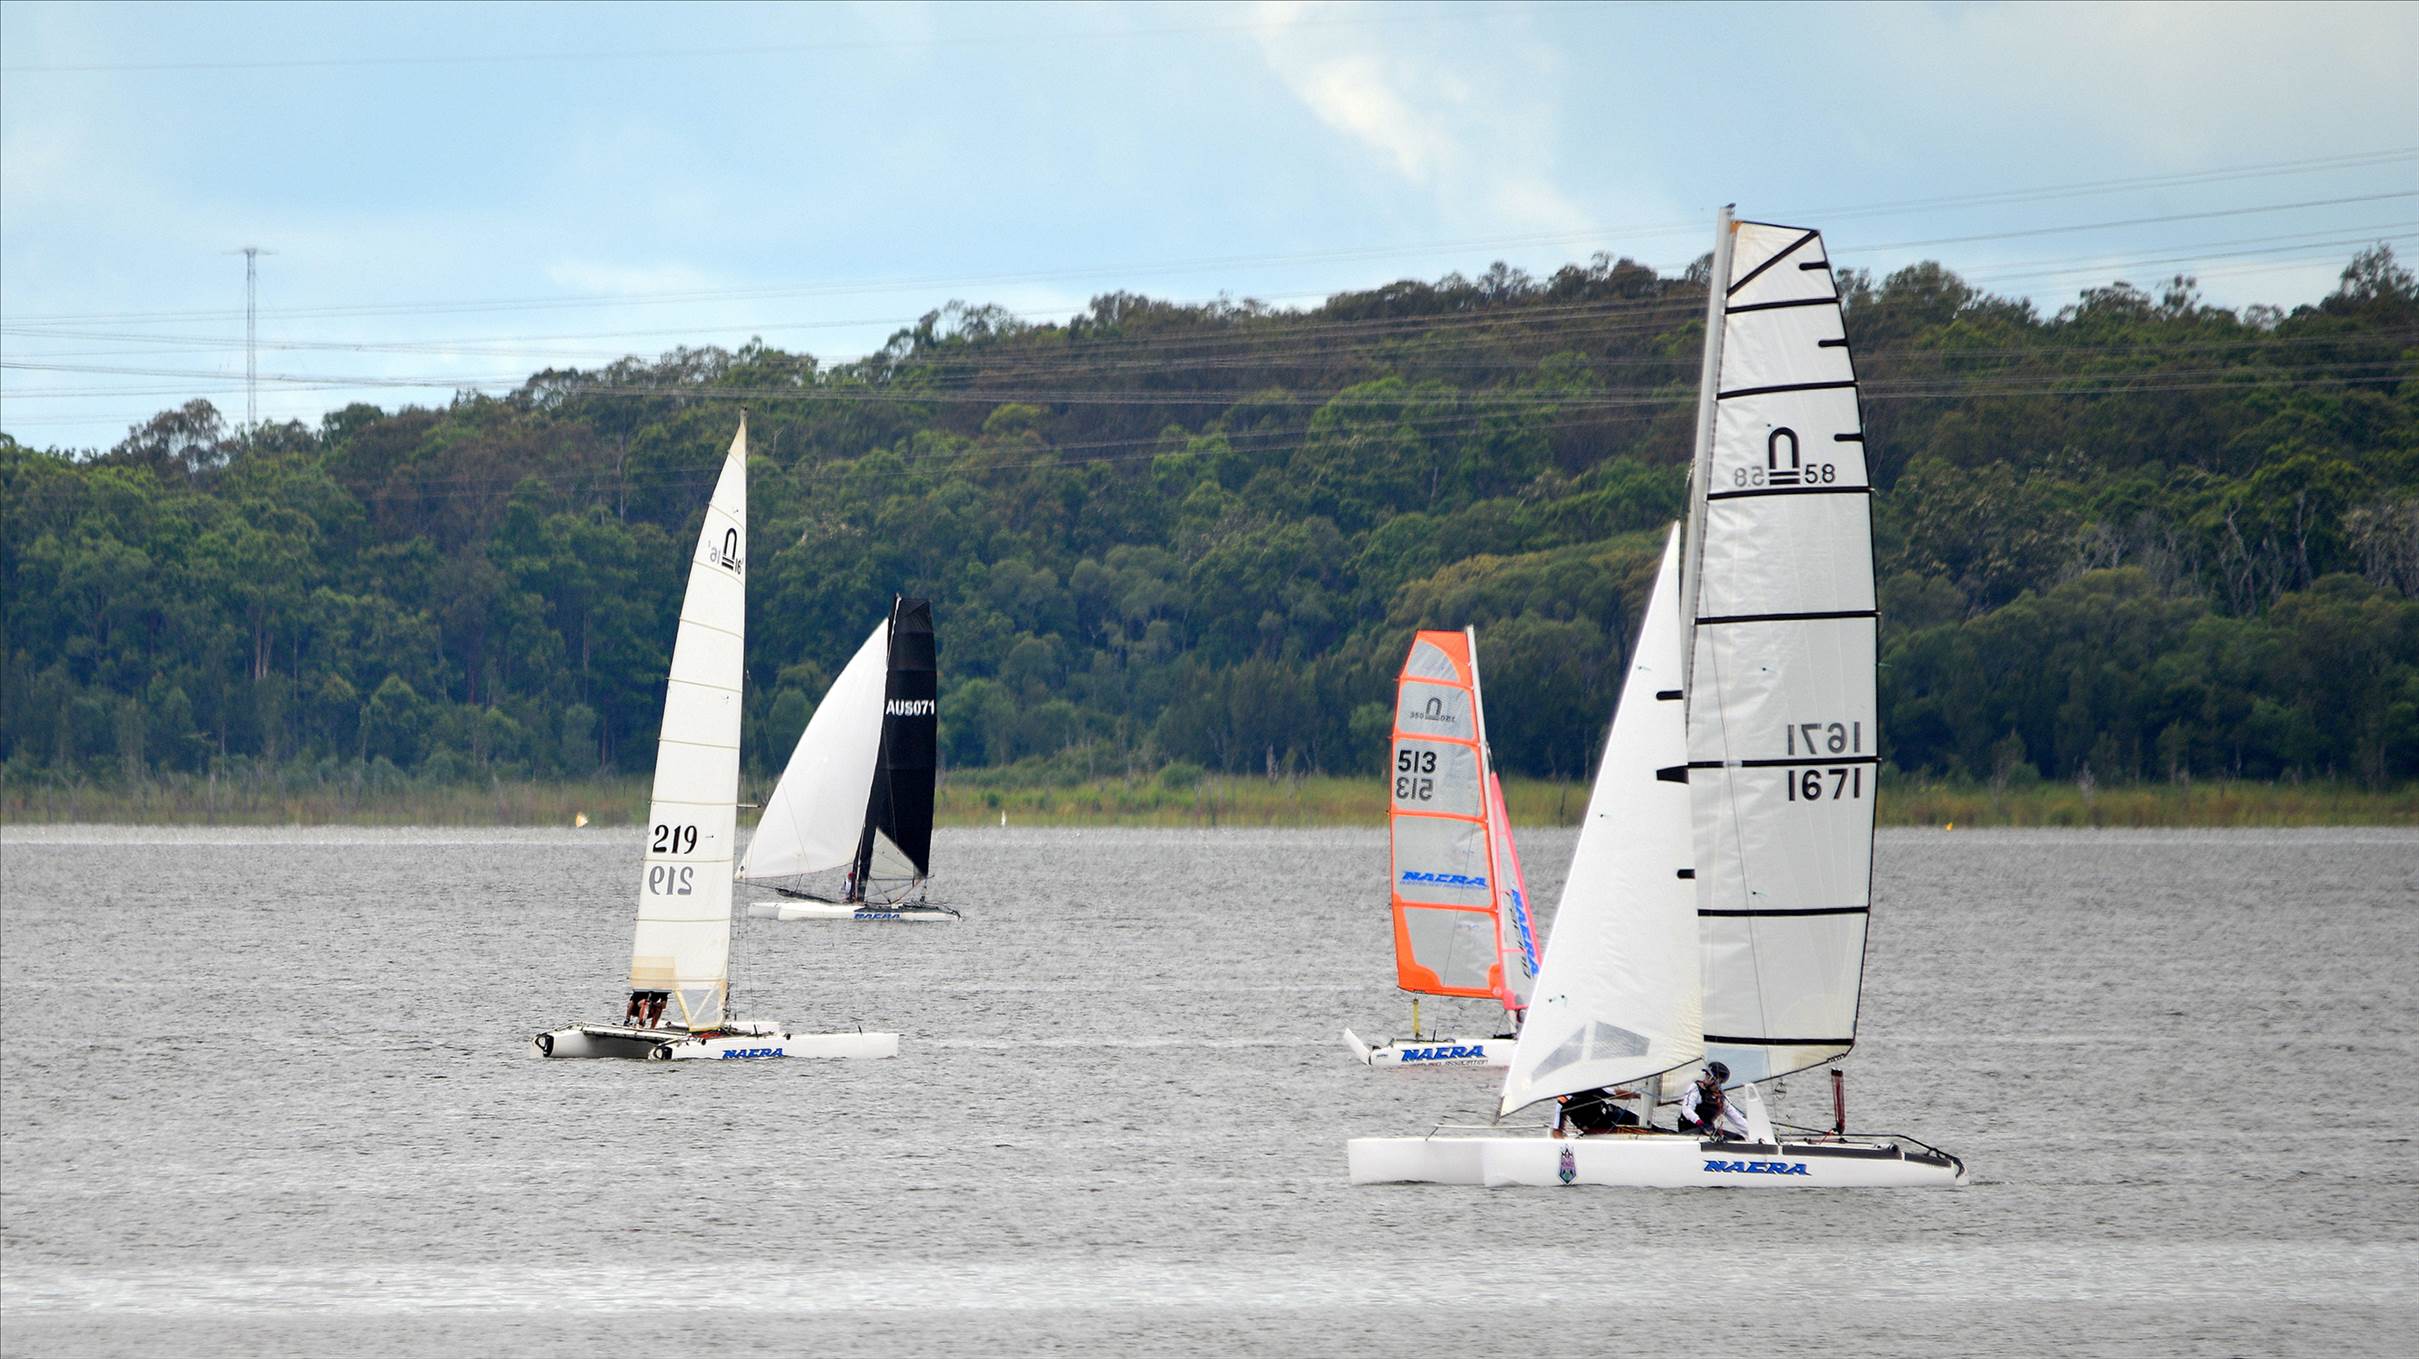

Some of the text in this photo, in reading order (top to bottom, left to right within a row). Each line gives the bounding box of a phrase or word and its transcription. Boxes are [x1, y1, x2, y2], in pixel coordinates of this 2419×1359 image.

[885, 698, 935, 716] AUS071
[1398, 749, 1437, 774] 513
[1788, 767, 1861, 801] 1671
[652, 824, 698, 854] 219
